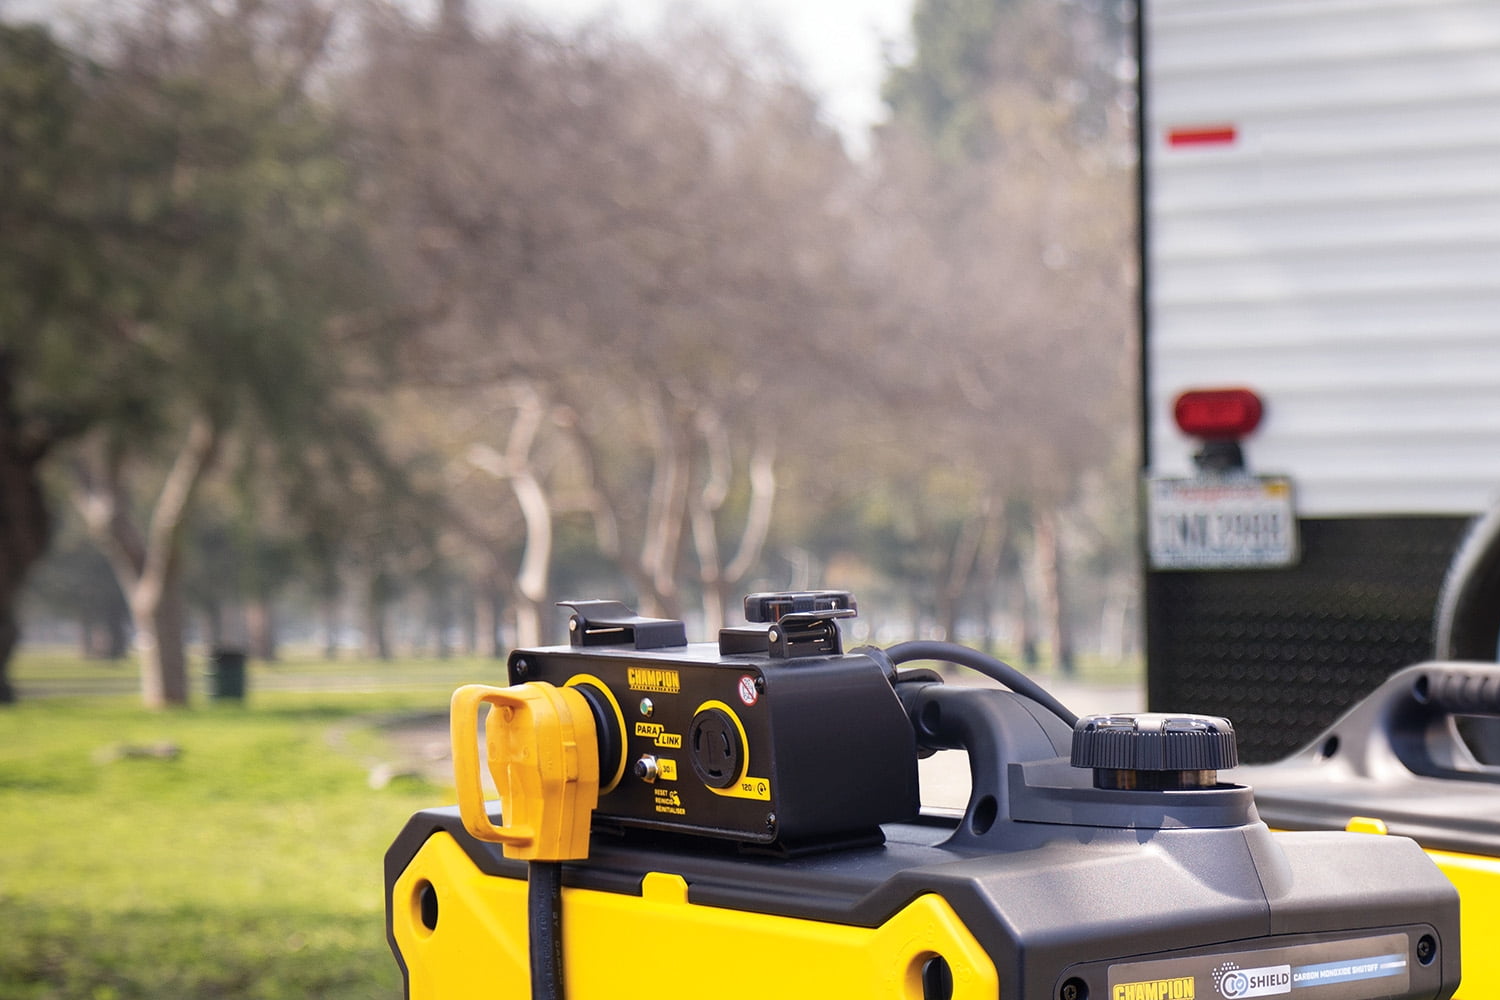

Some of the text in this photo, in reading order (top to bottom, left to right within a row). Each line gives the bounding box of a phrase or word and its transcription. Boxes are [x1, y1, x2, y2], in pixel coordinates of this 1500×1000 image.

[628, 668, 680, 688] CHAMPION
[637, 725, 657, 735] PARA
[662, 736, 680, 745] LINK
[1250, 973, 1289, 989] SHIELD
[1293, 971, 1319, 982] CARBON
[1320, 967, 1351, 978] MONOXIDE
[1352, 963, 1378, 974] SHUTOFF
